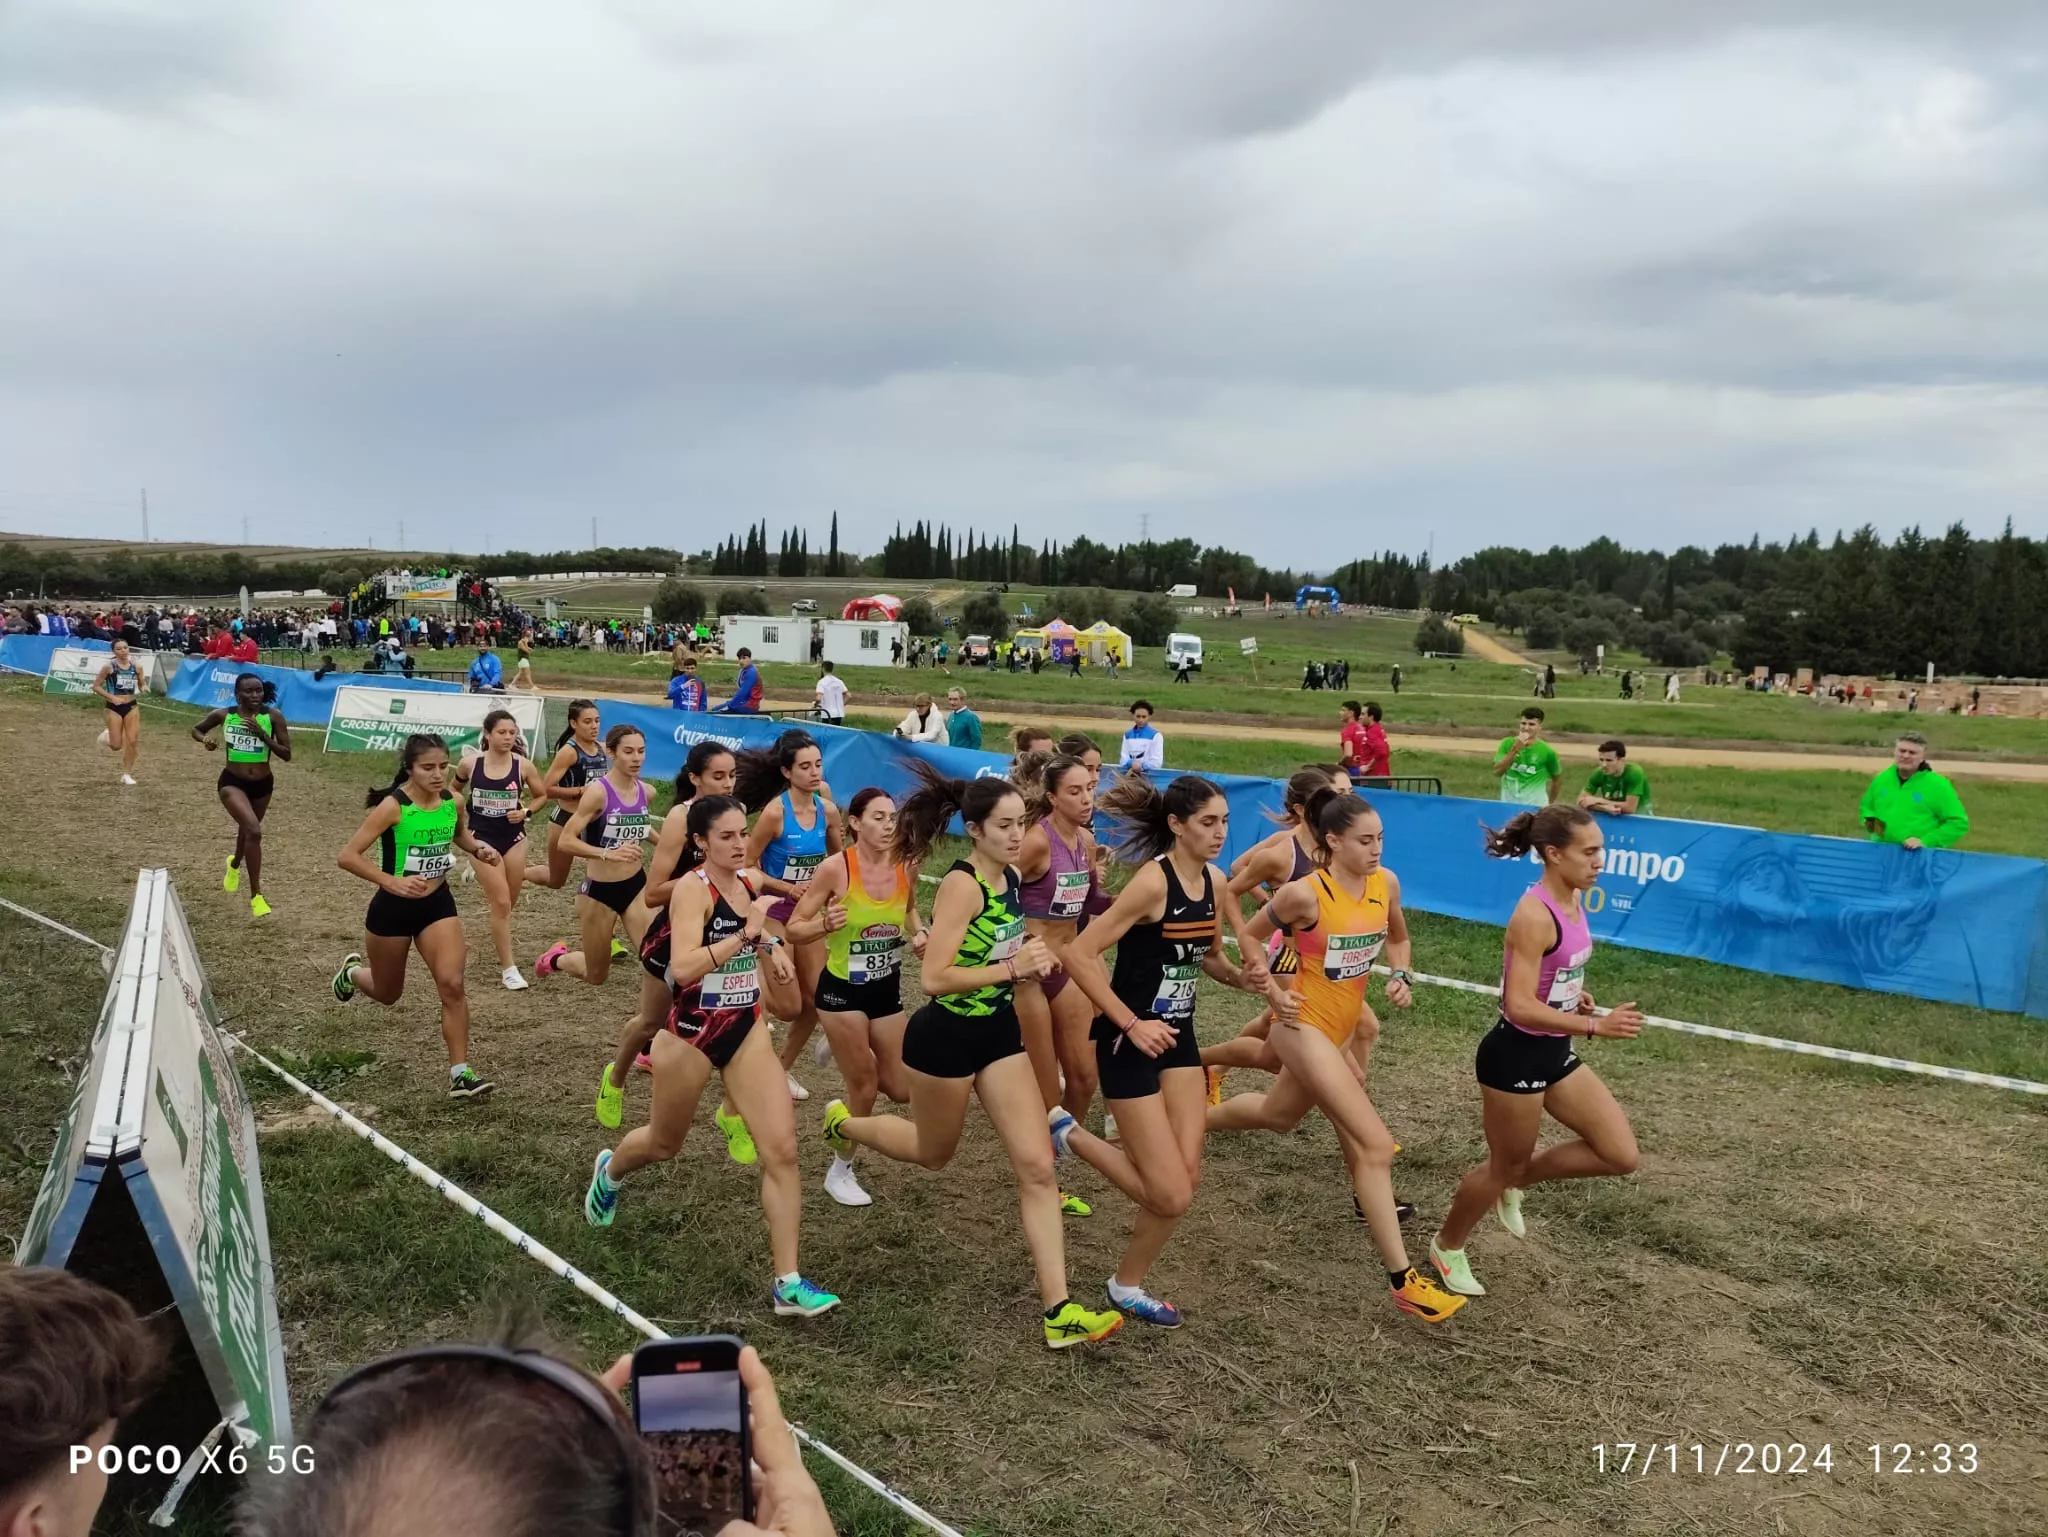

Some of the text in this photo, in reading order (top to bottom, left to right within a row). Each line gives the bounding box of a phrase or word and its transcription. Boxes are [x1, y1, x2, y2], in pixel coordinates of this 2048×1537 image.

[340, 719, 466, 737] CROSS INTERNACIONAL
[231, 735, 258, 746] 1661
[365, 732, 403, 751] ITÁL
[615, 826, 645, 839] 1098
[417, 856, 450, 871] 1664
[865, 928, 898, 938] Serrano
[866, 951, 894, 970] 835
[722, 974, 755, 990] ESPEJO
[1168, 981, 1196, 999] 218
